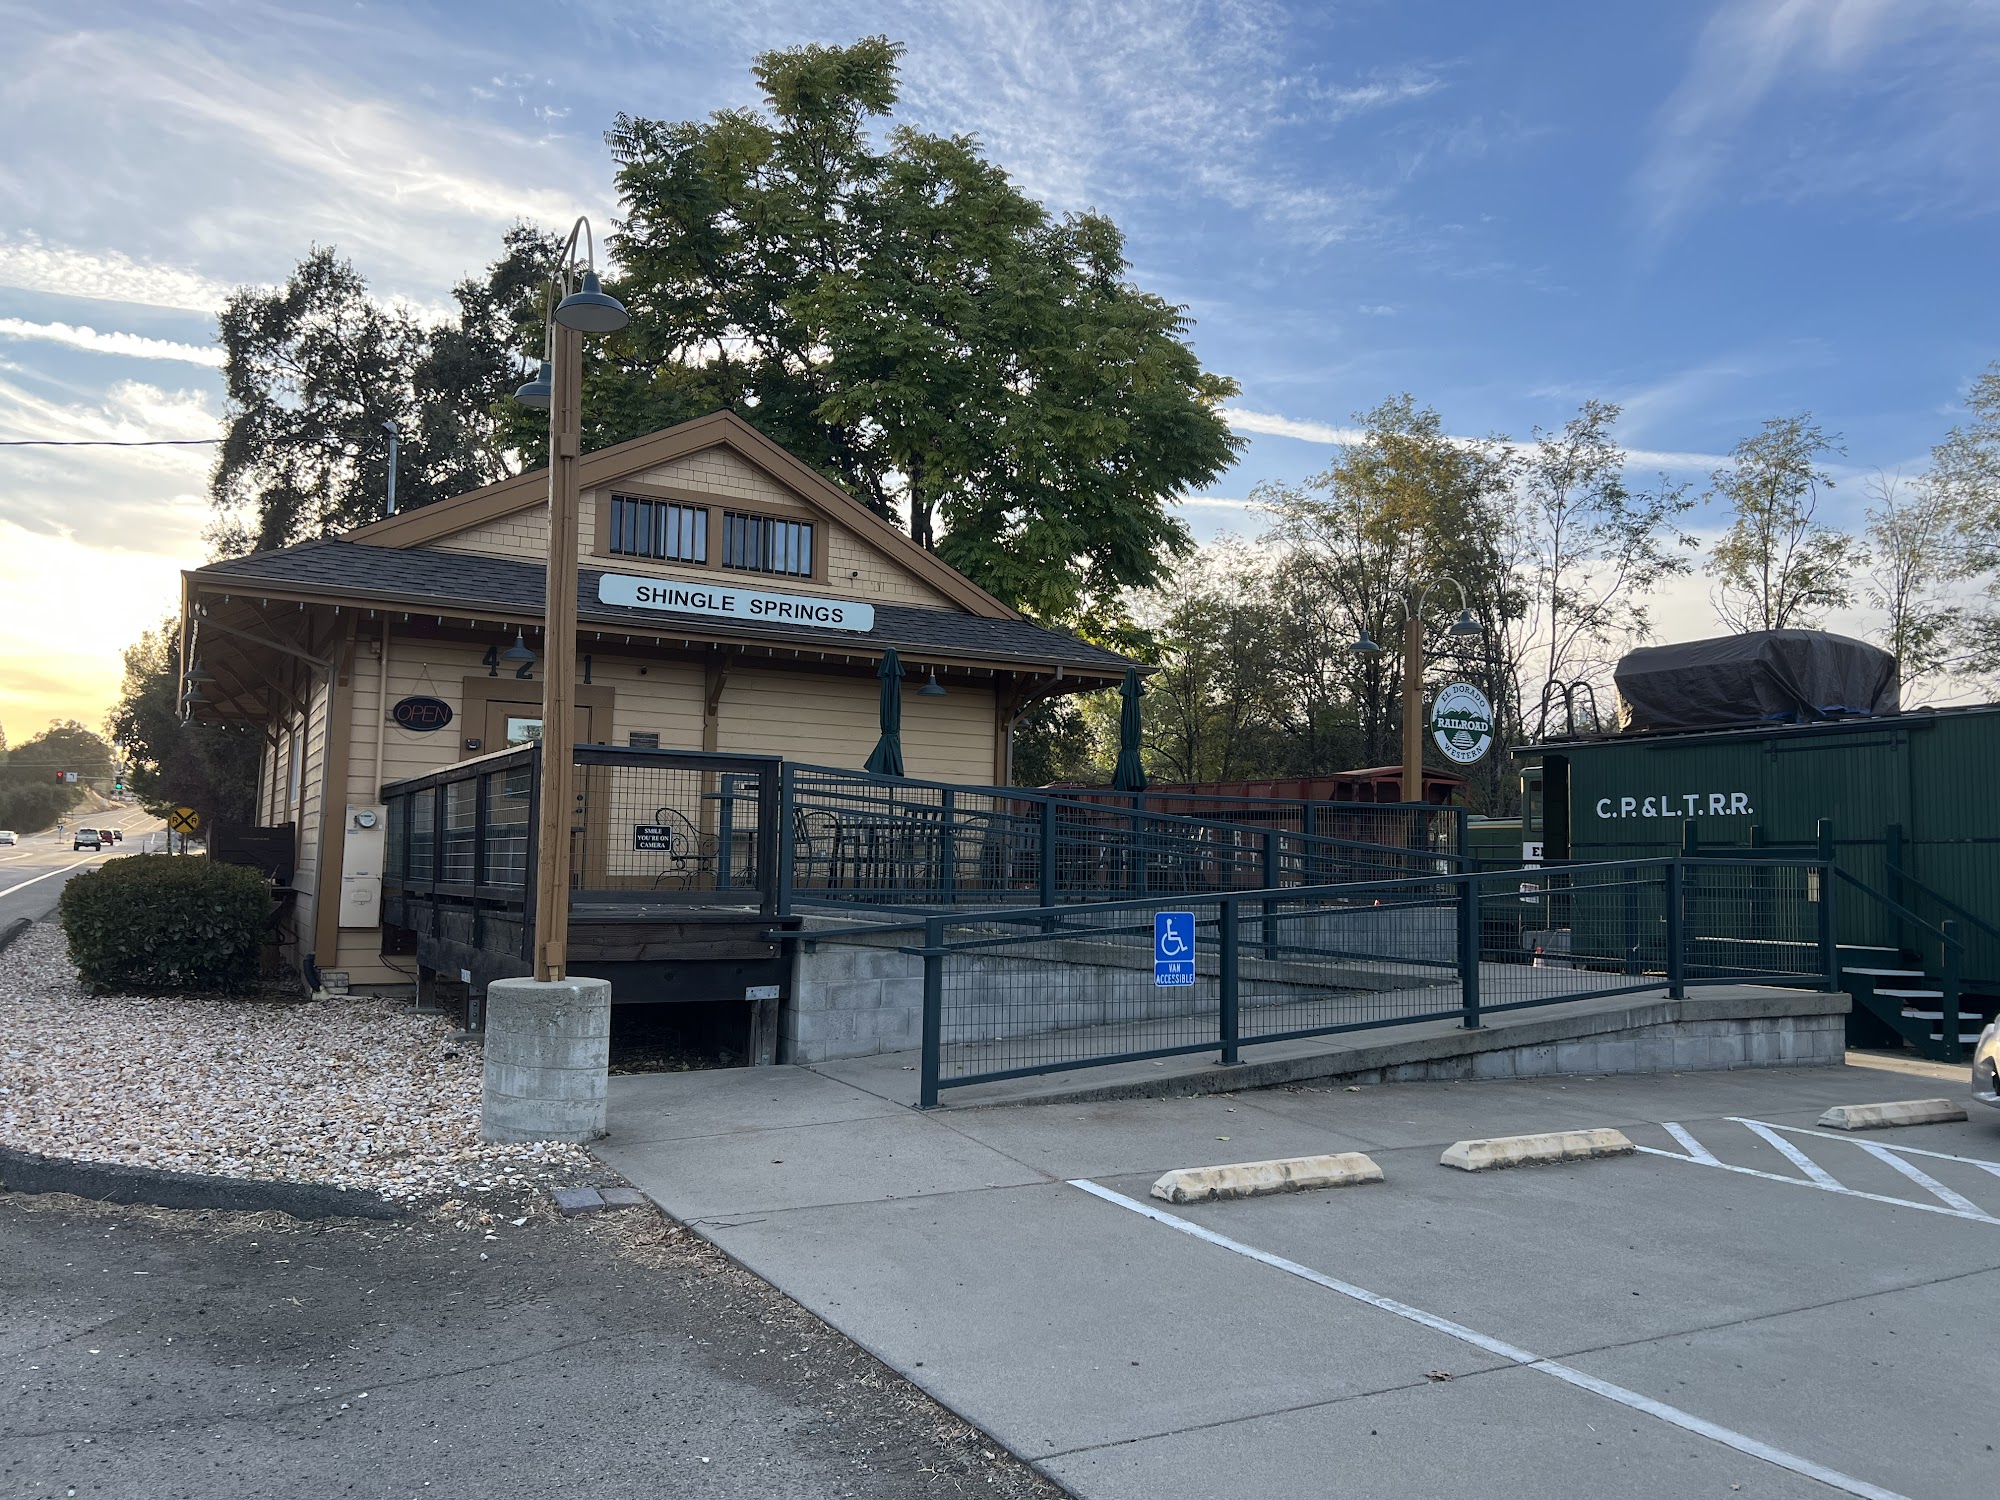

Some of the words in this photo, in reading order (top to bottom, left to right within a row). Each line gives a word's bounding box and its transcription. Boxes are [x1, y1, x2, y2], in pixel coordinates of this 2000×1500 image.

[636, 586, 735, 612] SHINGLE
[750, 599, 844, 623] SPRINGS
[1441, 691, 1451, 702] EL
[1453, 685, 1485, 708] DORADO
[397, 704, 451, 723] OPEN
[1437, 717, 1488, 732] RAILROAD
[1444, 742, 1483, 760] WESTERN
[1168, 963, 1181, 973] VAN
[1156, 973, 1193, 984] ACCESSIBLE
